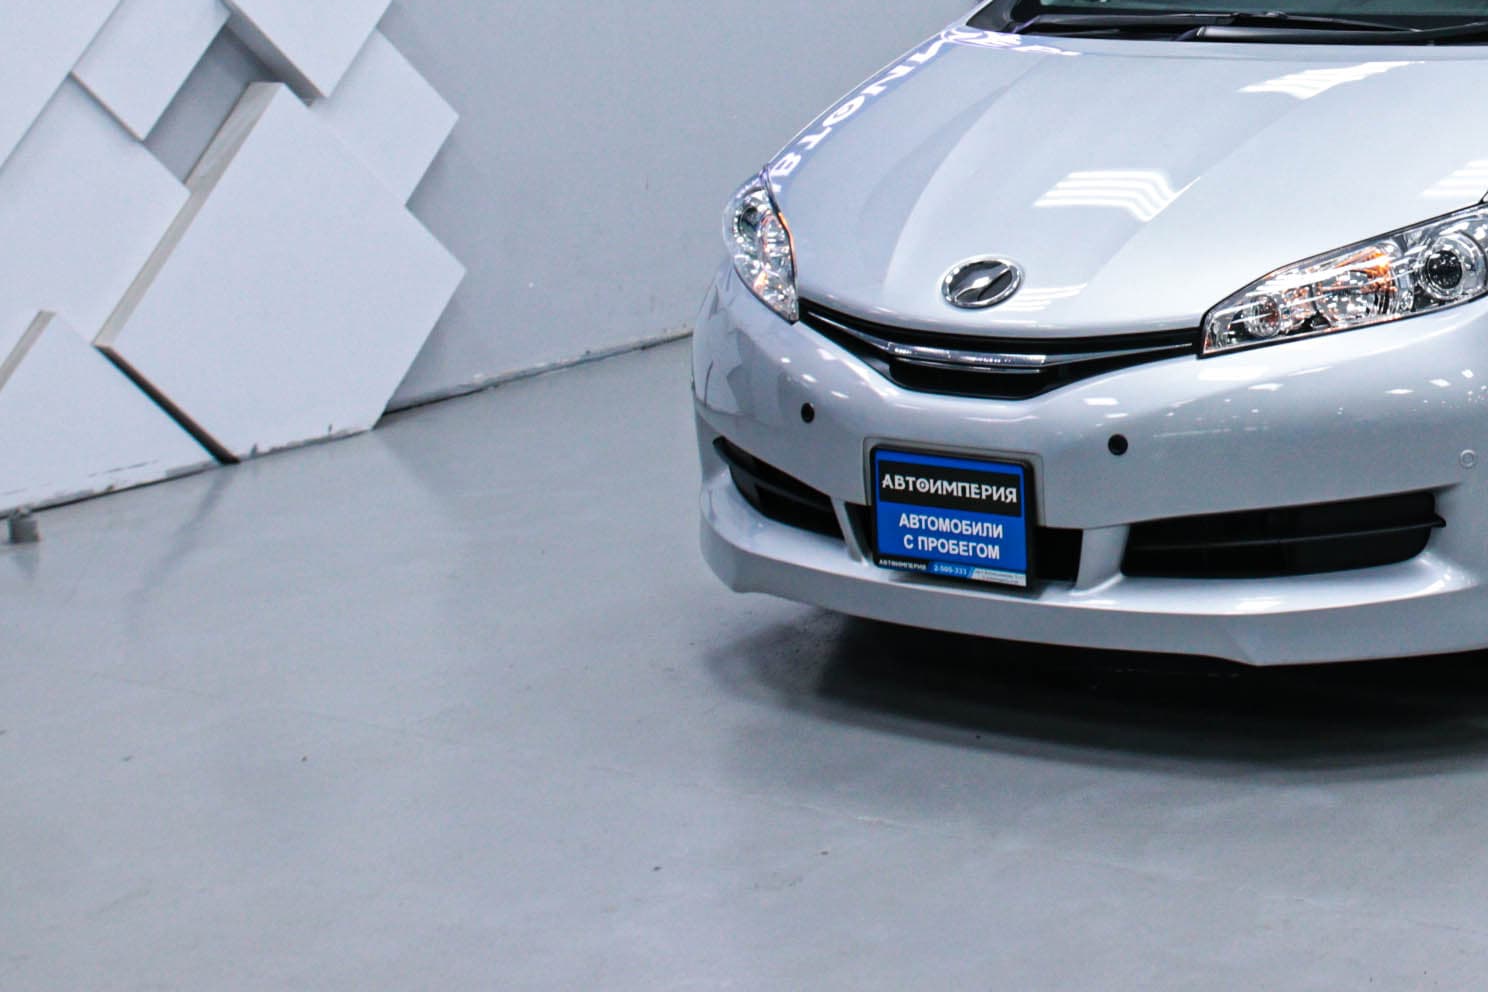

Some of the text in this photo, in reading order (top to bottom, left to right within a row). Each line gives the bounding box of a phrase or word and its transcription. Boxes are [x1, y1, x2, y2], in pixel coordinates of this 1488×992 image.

[881, 473, 1018, 504] АВТОИМПЕРИЯ
[898, 512, 1004, 540] АВТОМОБИЛИ
[903, 534, 1001, 560] С ПРОБЕГОМ
